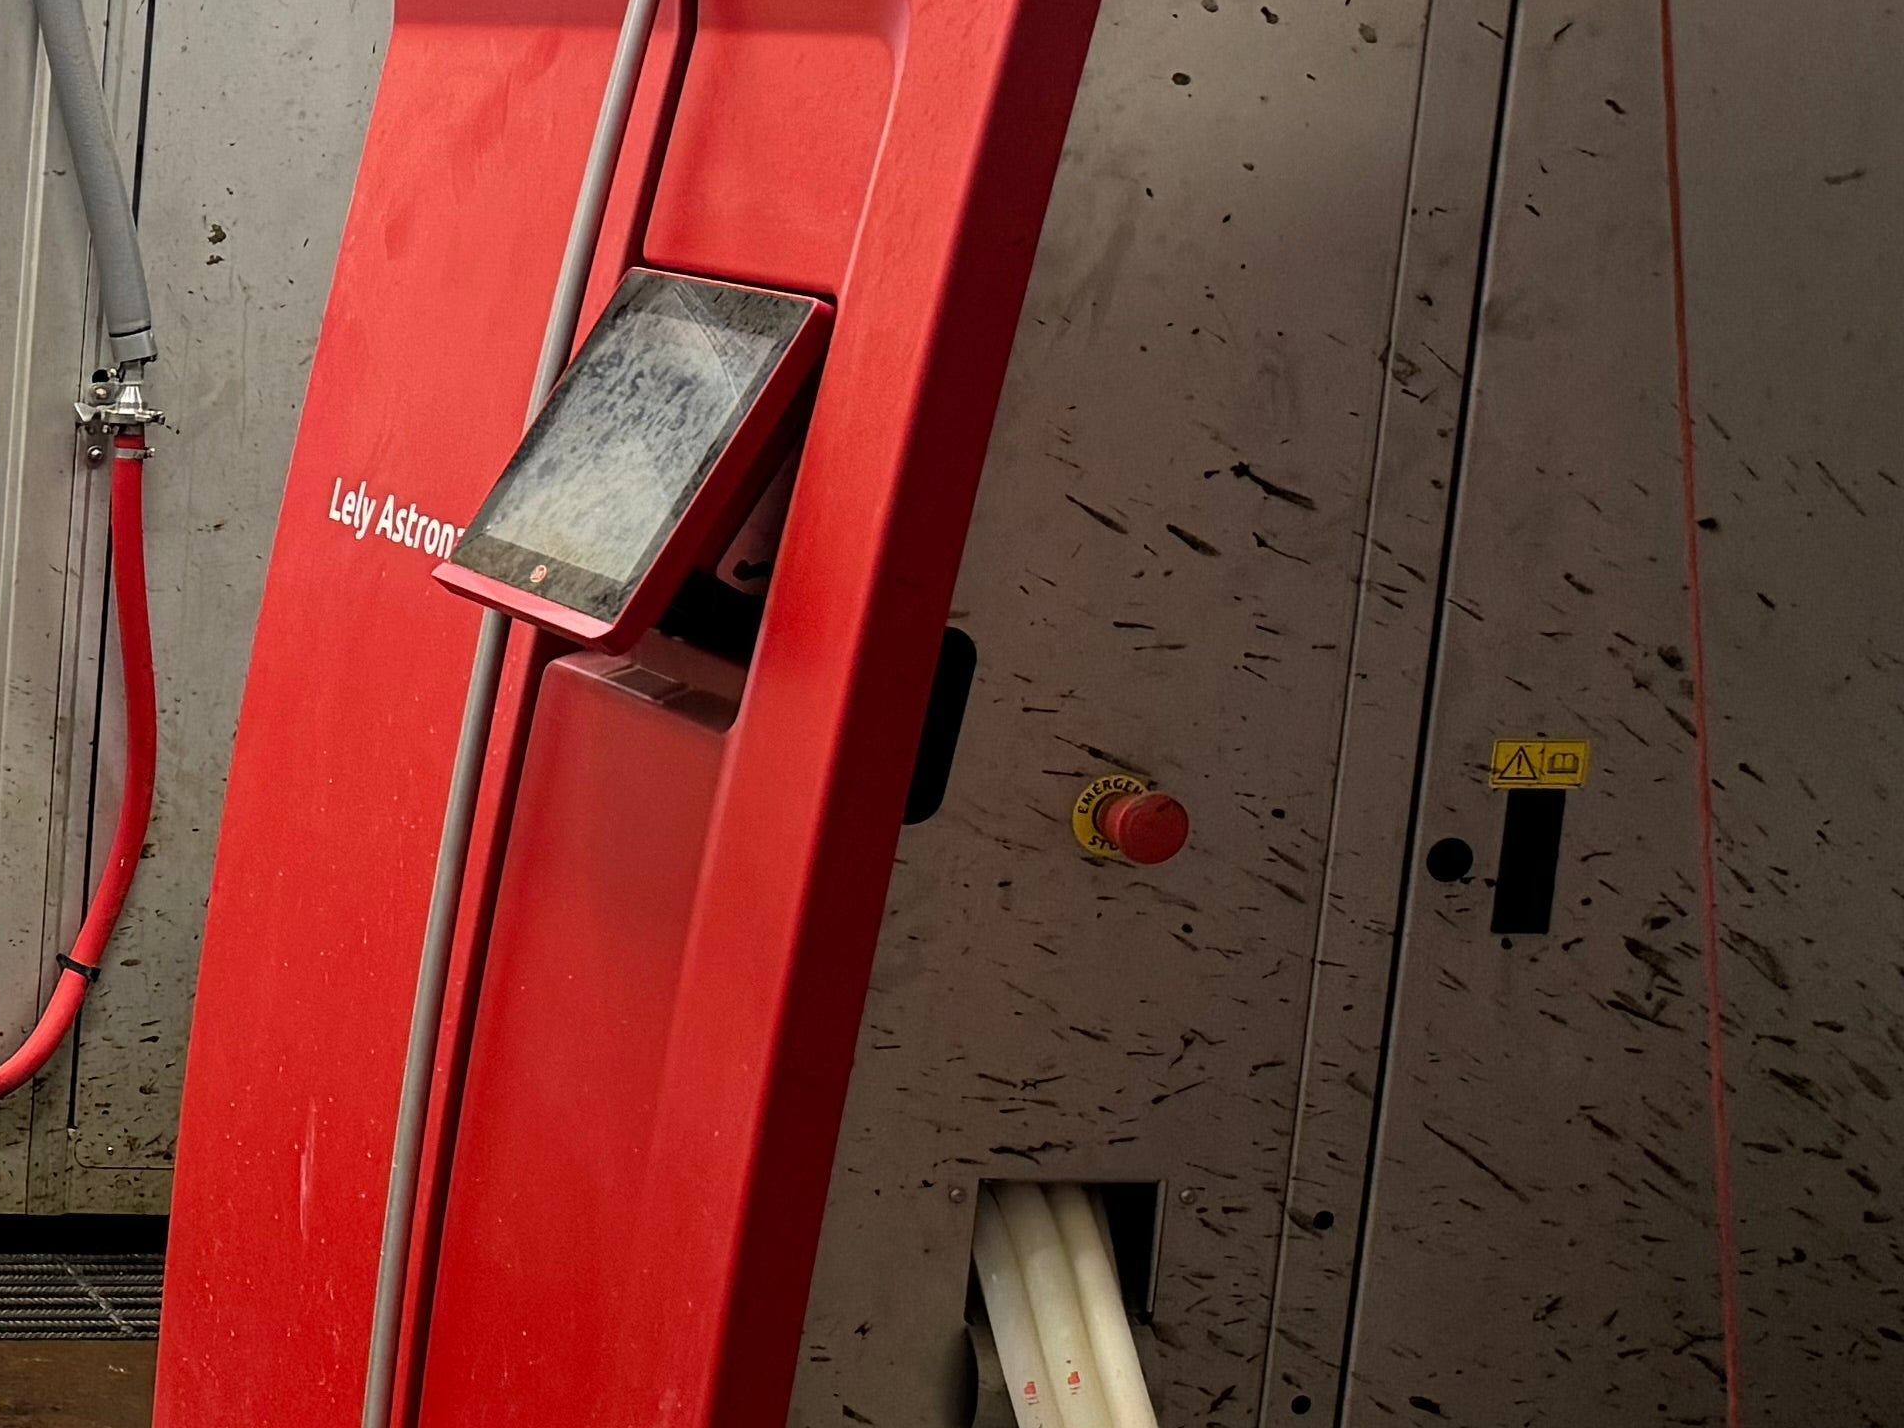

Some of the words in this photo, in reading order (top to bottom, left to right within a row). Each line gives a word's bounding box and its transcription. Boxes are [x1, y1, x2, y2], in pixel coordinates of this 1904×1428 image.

[329, 476, 377, 540] Lely
[375, 494, 466, 560] Astron
[1077, 777, 1144, 814] EMERGEN
[1089, 835, 1120, 852] STO
